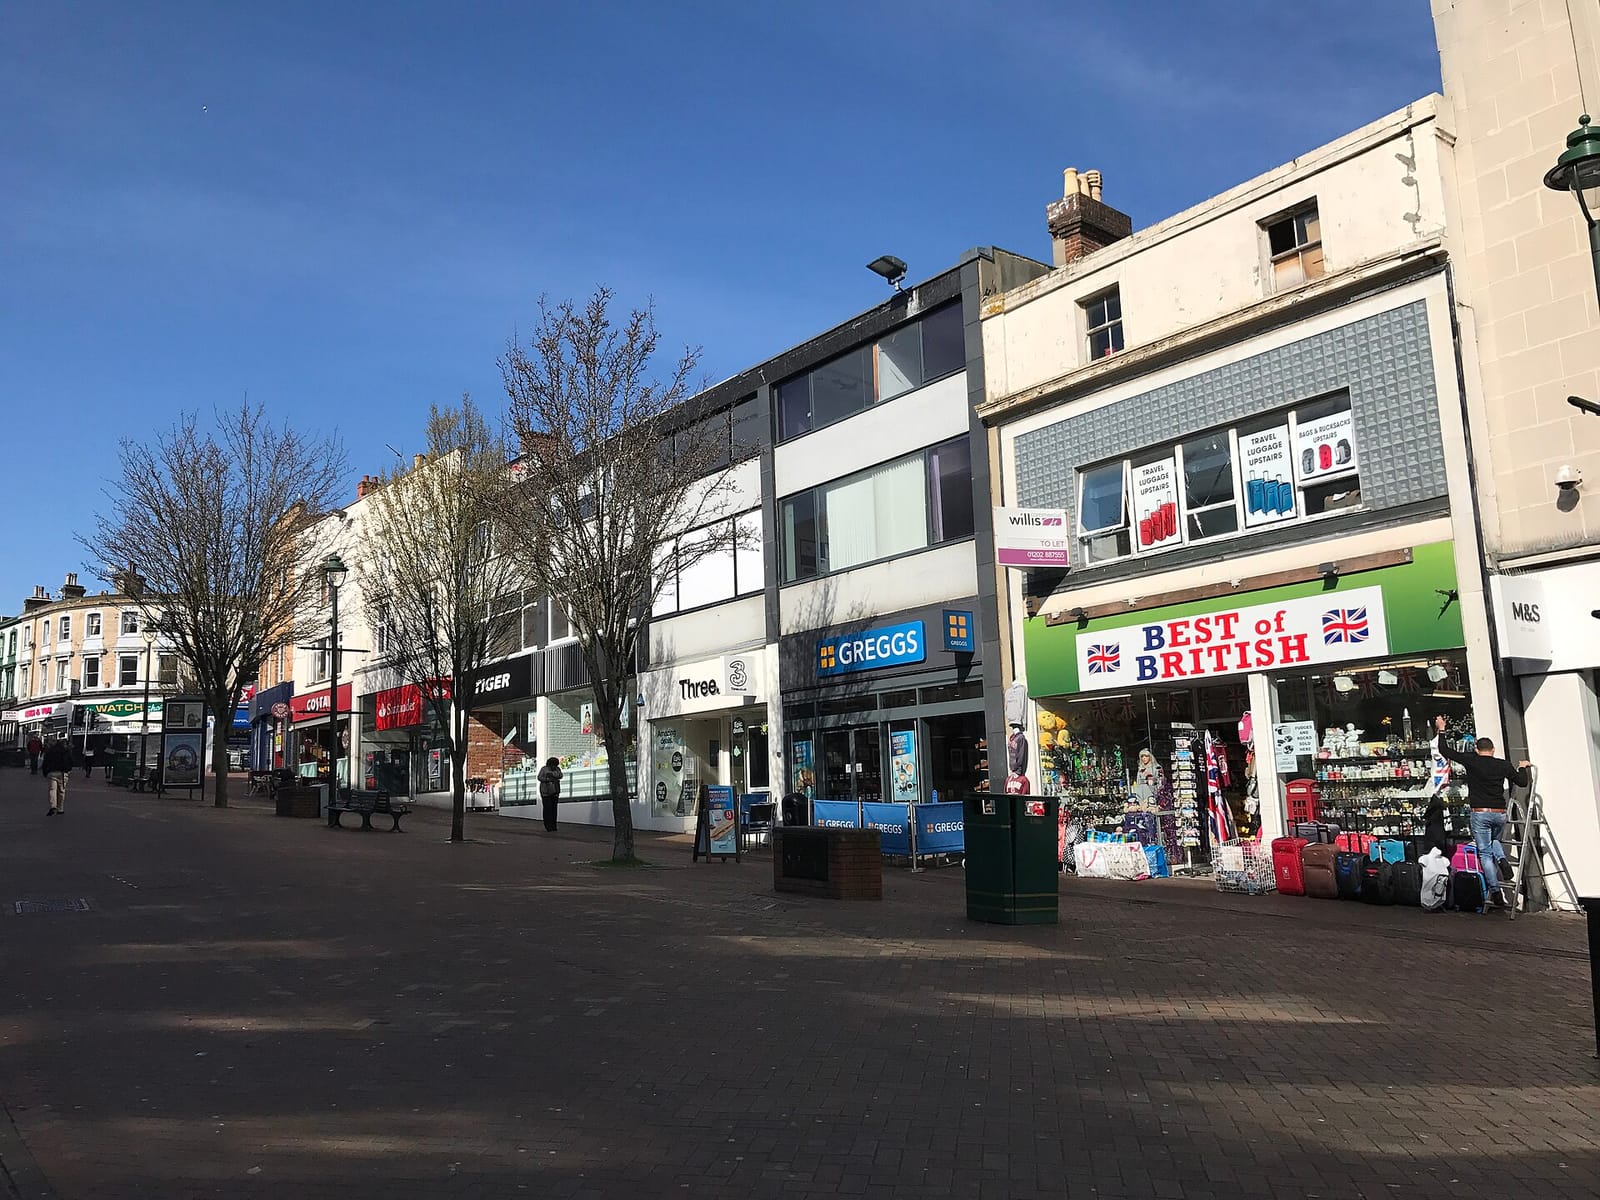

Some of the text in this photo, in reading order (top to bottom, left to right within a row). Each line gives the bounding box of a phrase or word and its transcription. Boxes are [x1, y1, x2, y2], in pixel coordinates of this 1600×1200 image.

[1299, 428, 1313, 438] BAGS
[1319, 418, 1351, 433] RUCKSACKS
[1251, 433, 1276, 445] TRAVEL
[1312, 431, 1338, 443] UPSTAIRS
[1247, 441, 1282, 456] LUGGAGE
[1249, 452, 1282, 466] UPSTAIRS
[1142, 465, 1164, 476] TRAVEL
[1139, 472, 1169, 487] LUGGAGE
[1140, 482, 1169, 495] UPSTAIRS
[1009, 513, 1041, 526] willis
[1512, 601, 1540, 622] M&S
[1142, 610, 1287, 651] BEST of
[839, 630, 918, 664] GREGGS
[1135, 633, 1310, 681] BRITISH
[730, 660, 747, 687] 3
[474, 672, 511, 694] TIGER
[679, 679, 720, 700] Three.
[96, 703, 144, 713] WATCH
[306, 695, 331, 711] COSTA
[386, 699, 415, 716] Santander
[825, 819, 854, 829] GREGGS
[874, 823, 902, 834] GREGGS
[935, 821, 965, 833] GREGG
